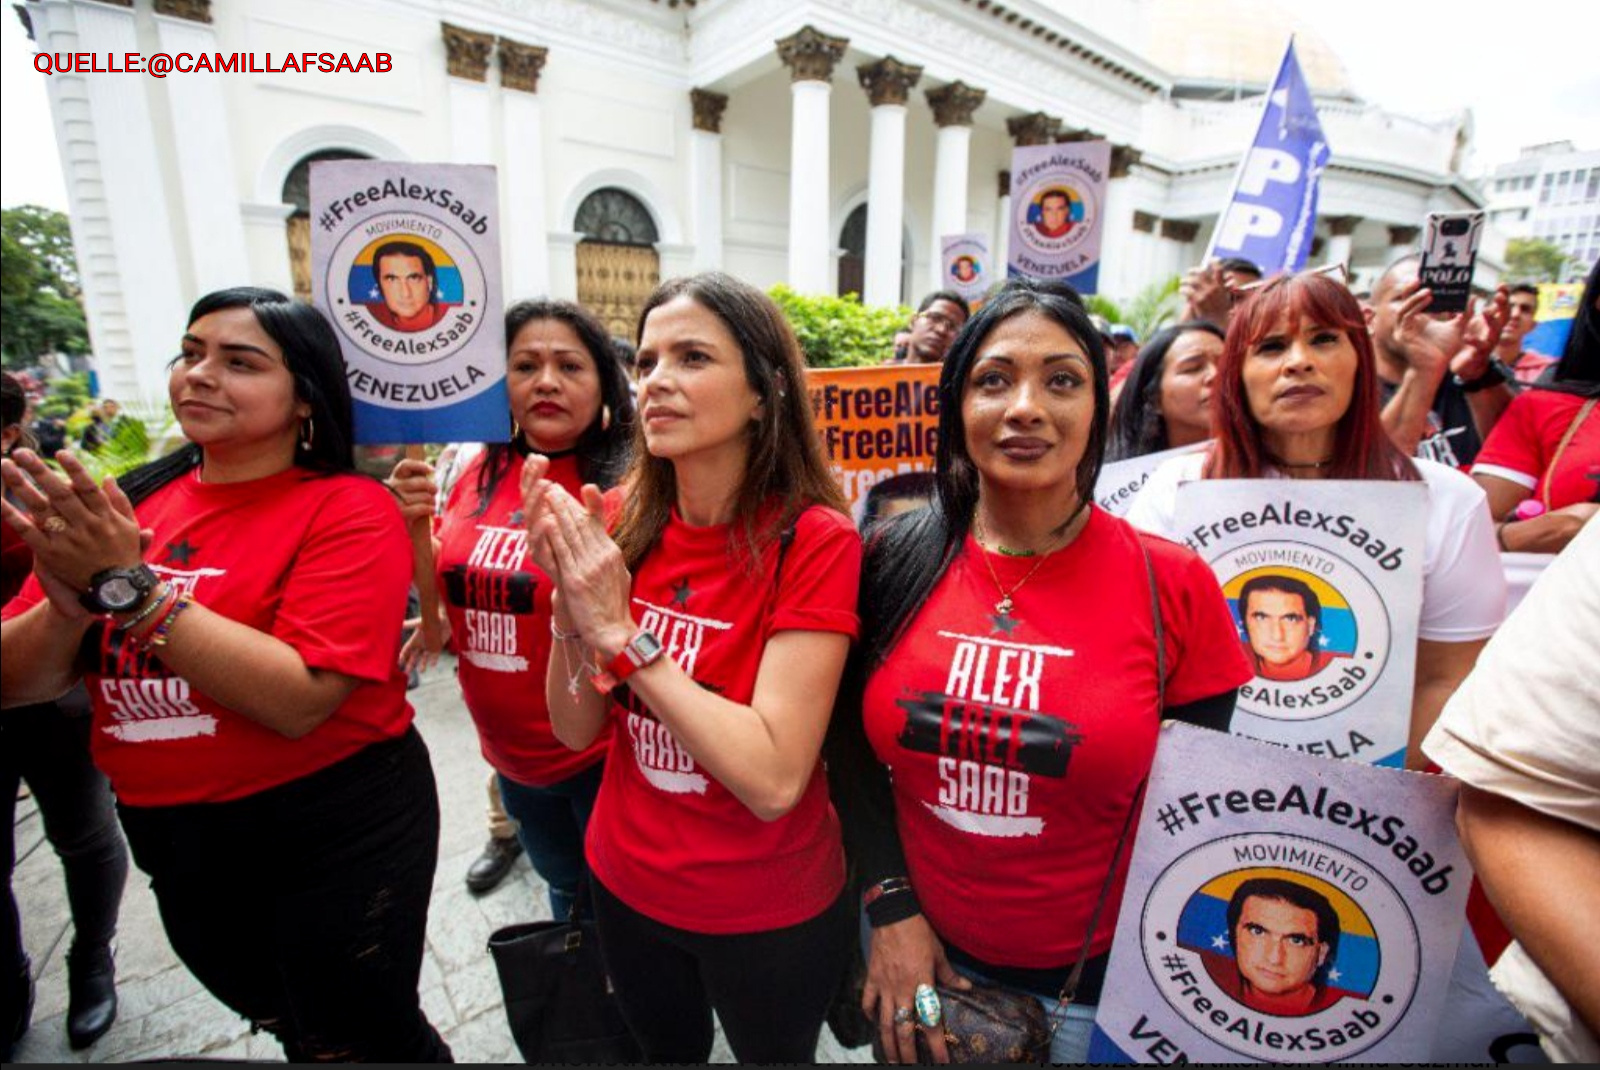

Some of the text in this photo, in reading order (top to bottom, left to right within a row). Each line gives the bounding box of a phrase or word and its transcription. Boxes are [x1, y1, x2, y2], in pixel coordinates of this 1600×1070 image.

[319, 177, 489, 237] #FreeAlexSaab
[365, 218, 443, 240] MOVIMIENTO
[1016, 253, 1090, 276] VENEZUELA
[344, 310, 475, 355] #FreeAlexSaab
[343, 362, 486, 403] VENEZUELA
[821, 422, 938, 461] FreeAle
[468, 530, 528, 571] ALEX
[1234, 548, 1335, 575] MOVIMIENTO
[466, 608, 518, 656] SAAB
[100, 676, 200, 722] SAAB
[944, 641, 1045, 712] ALEX
[939, 697, 1034, 770] FREE
[937, 756, 1031, 817] SAAB
[1155, 783, 1451, 897] #FreeAlexSaab
[1233, 844, 1369, 893] MOVIMIENTO
[1161, 952, 1382, 1052] #FreeAlexSaab
